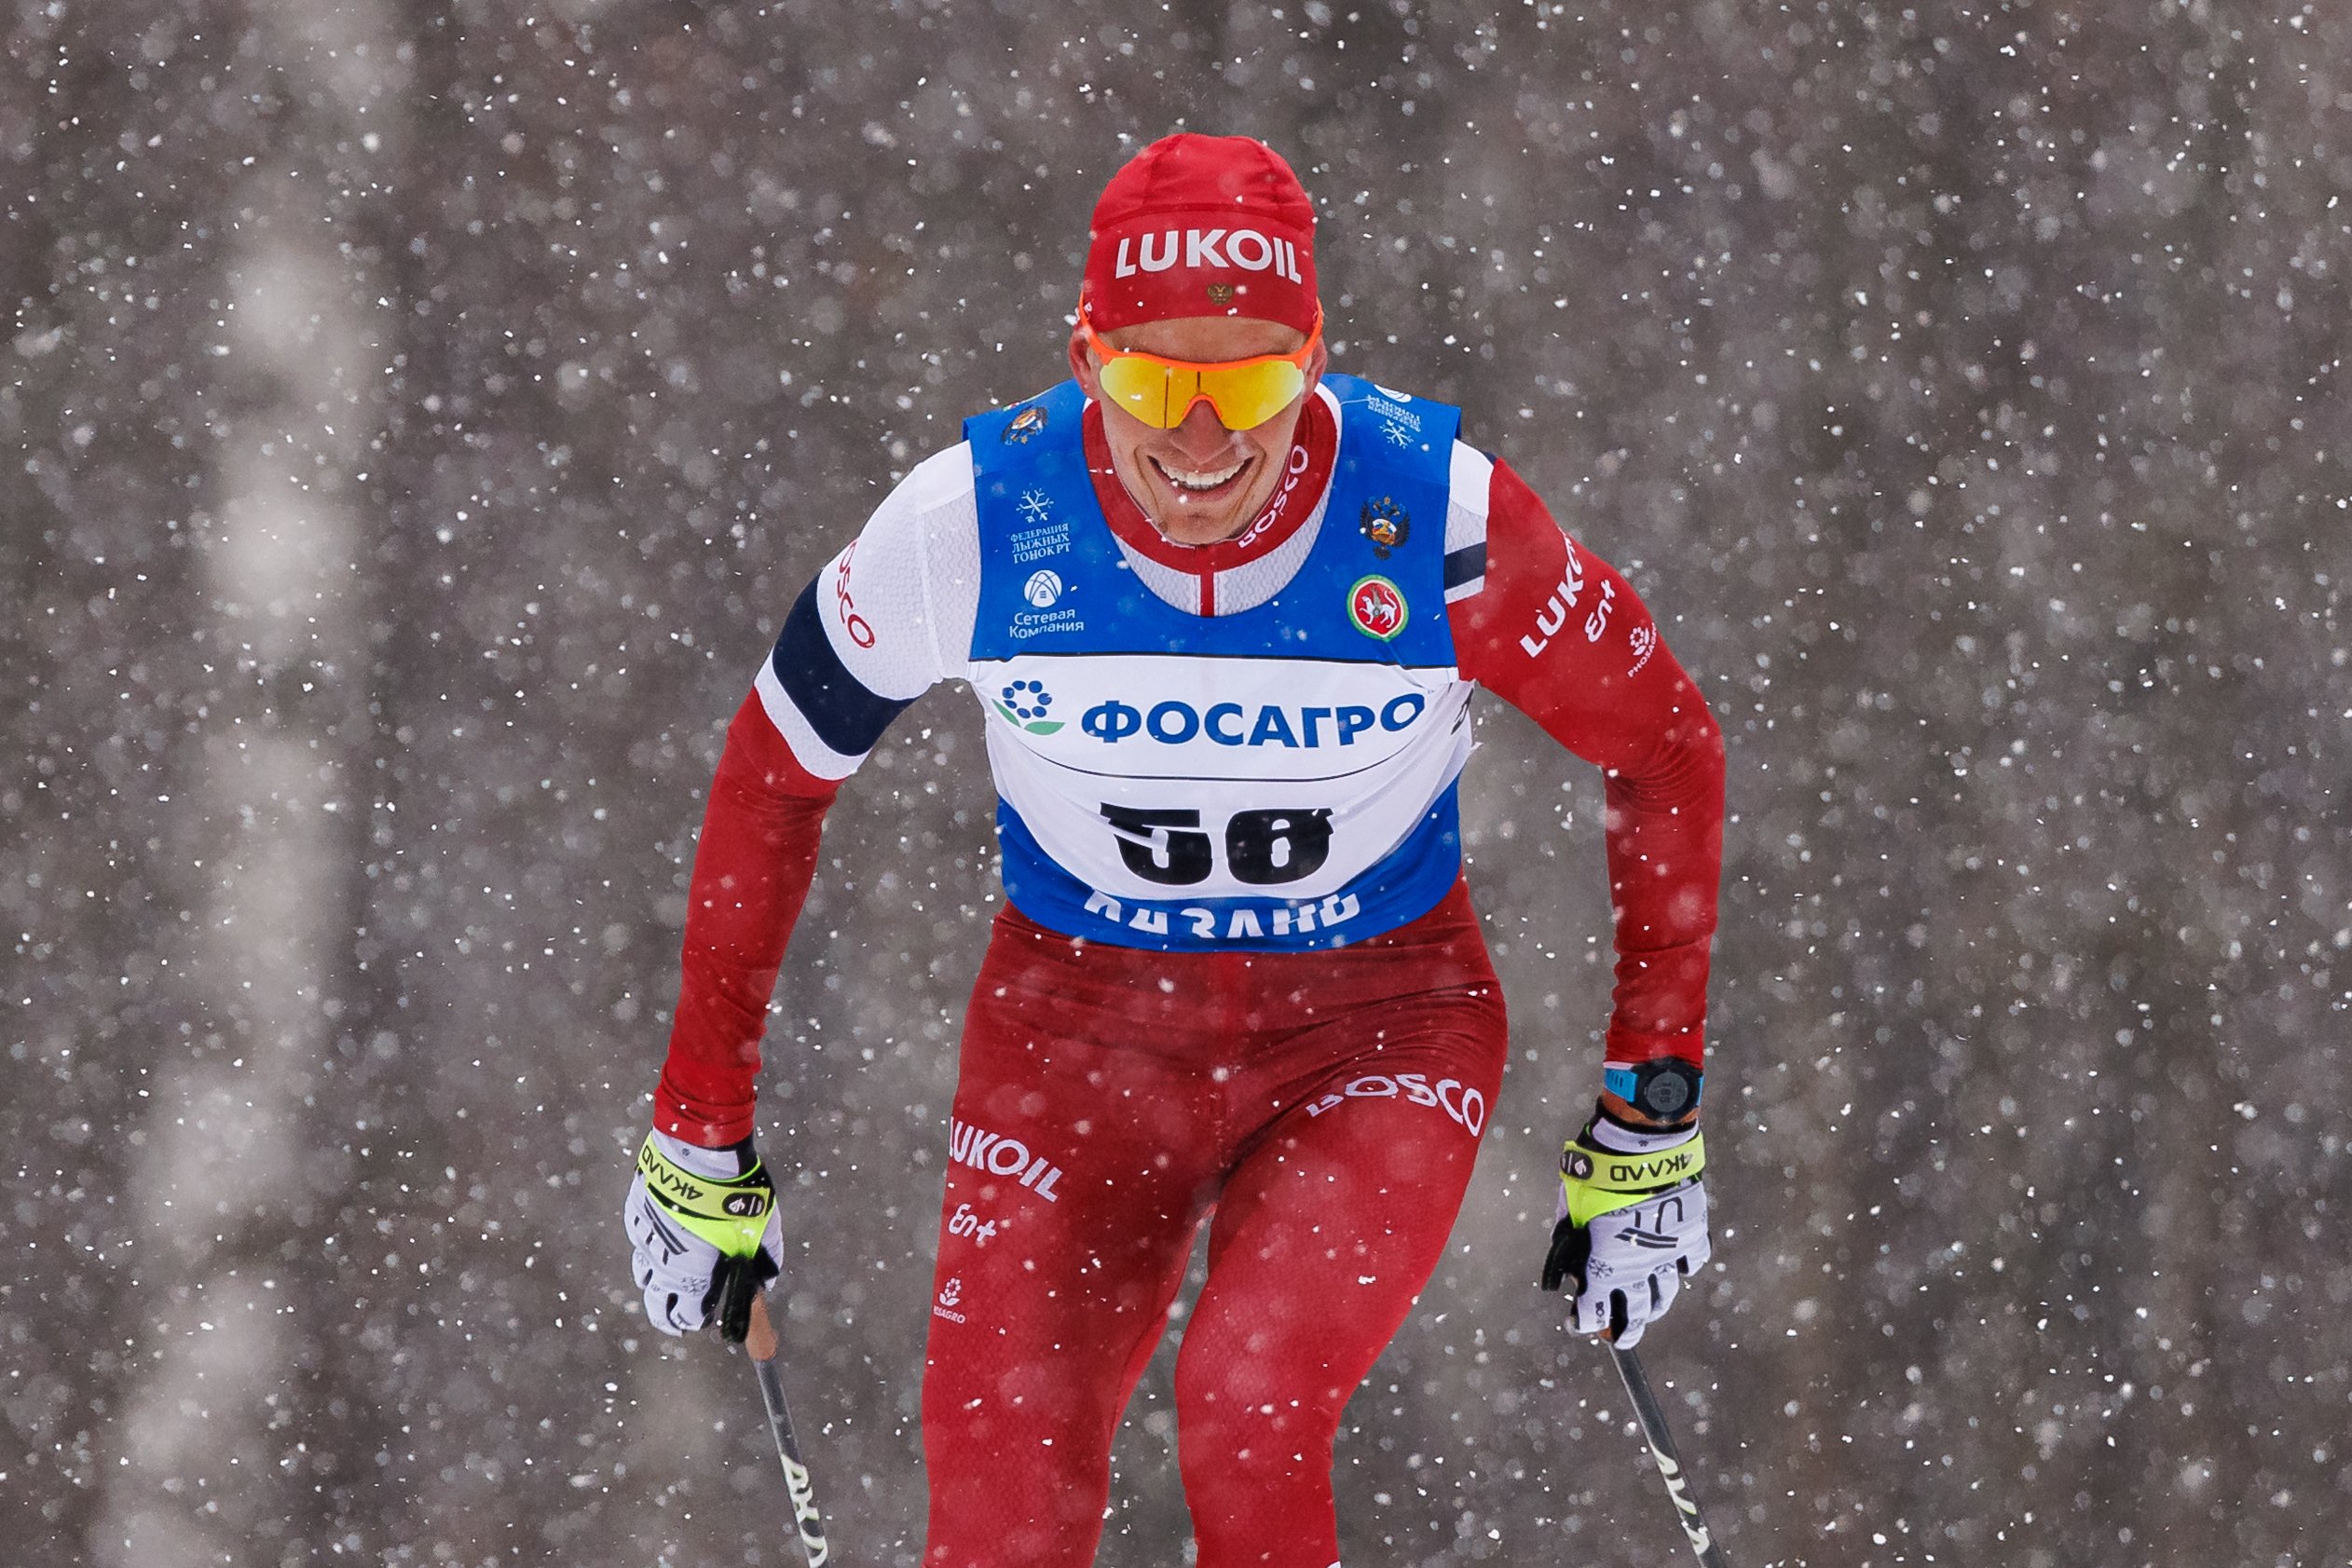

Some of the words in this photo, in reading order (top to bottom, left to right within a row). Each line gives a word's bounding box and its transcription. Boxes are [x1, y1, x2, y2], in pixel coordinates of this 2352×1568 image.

[1115, 229, 1302, 284] LUKOIL
[1010, 523, 1069, 542] ФЕДЕРАЦИЯ
[1011, 532, 1070, 552] ЛЫЖНЫХ
[1013, 545, 1055, 564] ГОНОК
[1056, 542, 1072, 554] РТ
[837, 539, 875, 648] OSCO
[1014, 608, 1075, 626] Сетевая
[1009, 621, 1085, 639] Компания
[1081, 692, 1425, 748] ФОСАГРО
